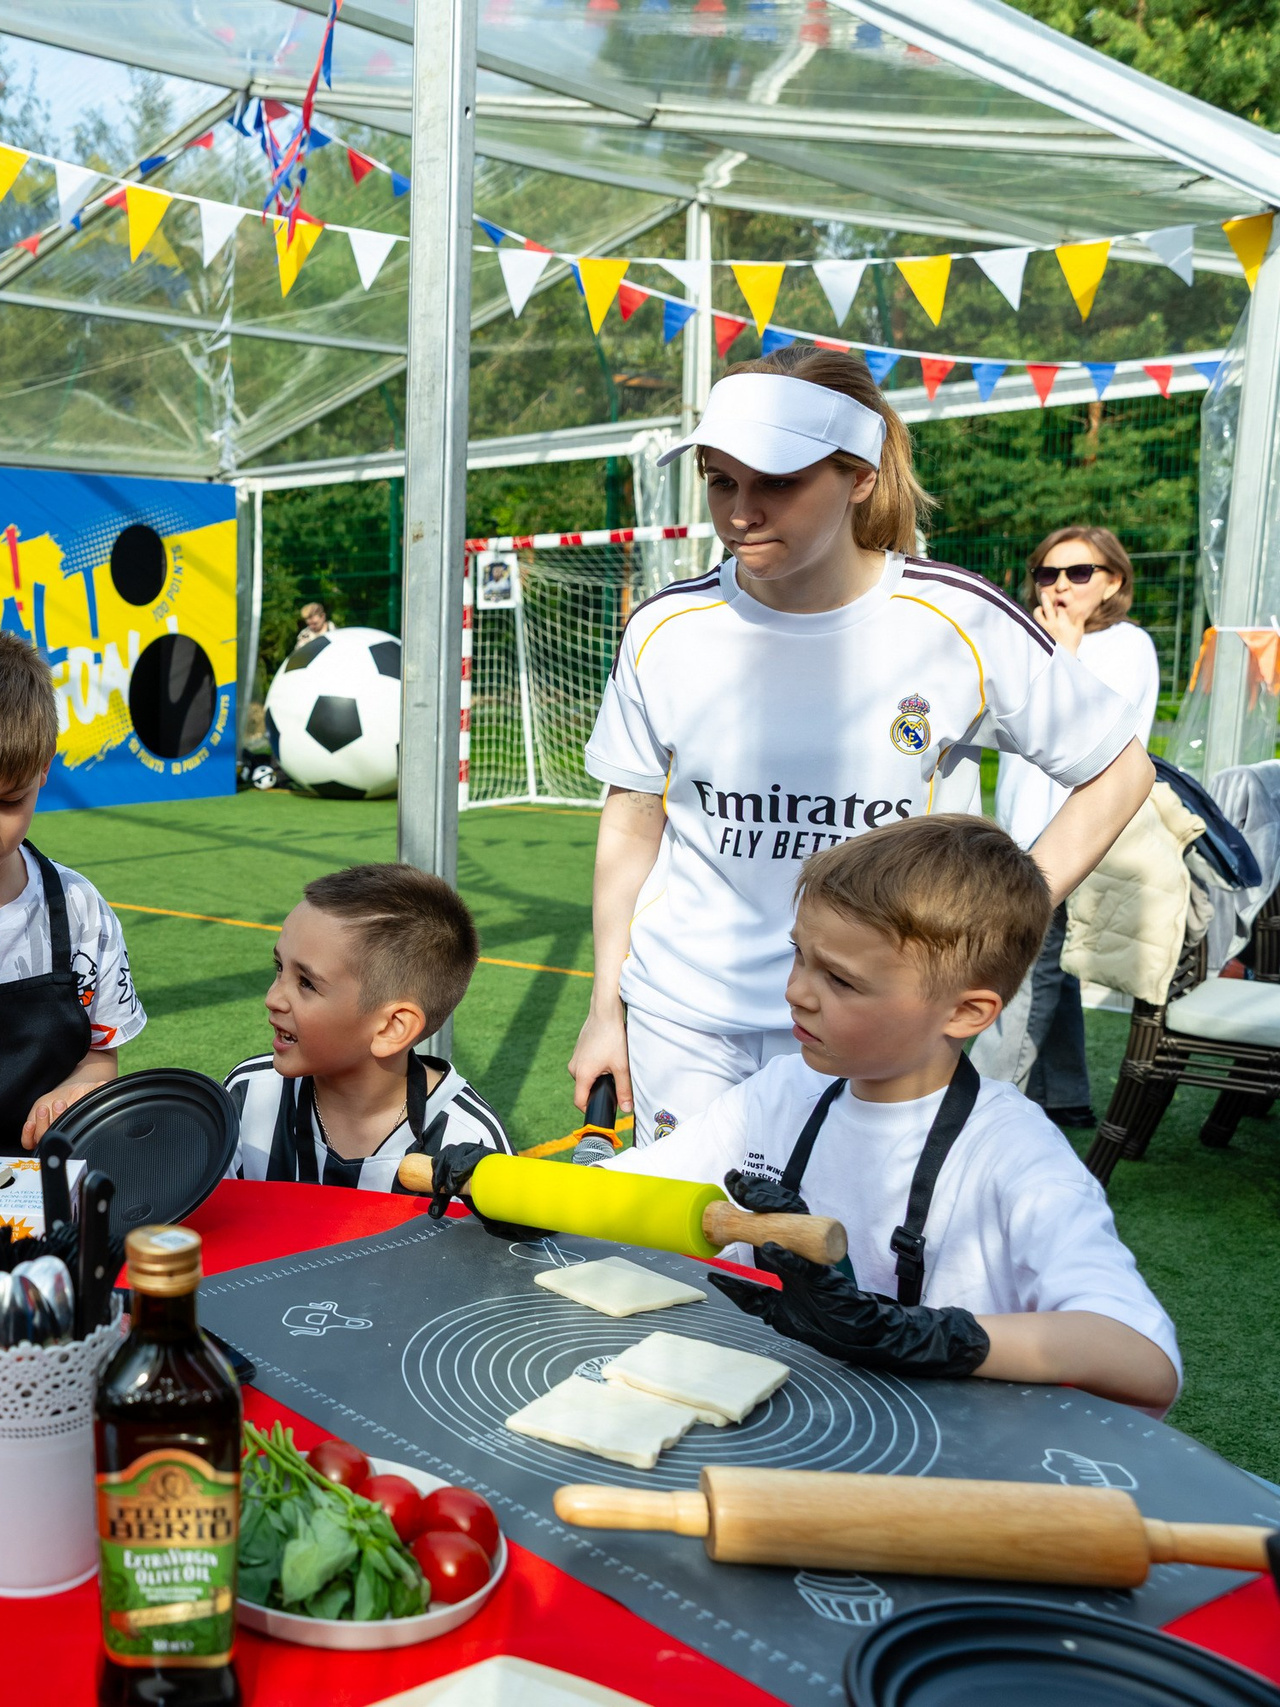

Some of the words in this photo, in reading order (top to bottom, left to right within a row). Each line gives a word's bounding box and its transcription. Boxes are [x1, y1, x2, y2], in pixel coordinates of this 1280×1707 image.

[167, 544, 185, 602] POINTS
[214, 695, 231, 733] POINTS
[136, 748, 166, 773] POINTS
[182, 746, 210, 773] POINTS
[691, 780, 912, 829] Emirates
[720, 827, 763, 859] FLY
[747, 1161, 765, 1170] JUST
[118, 1506, 227, 1519] FILIPPO
[110, 1518, 232, 1539] BERIO
[135, 1567, 181, 1586] OLIVE
[183, 1564, 211, 1583] OIL
